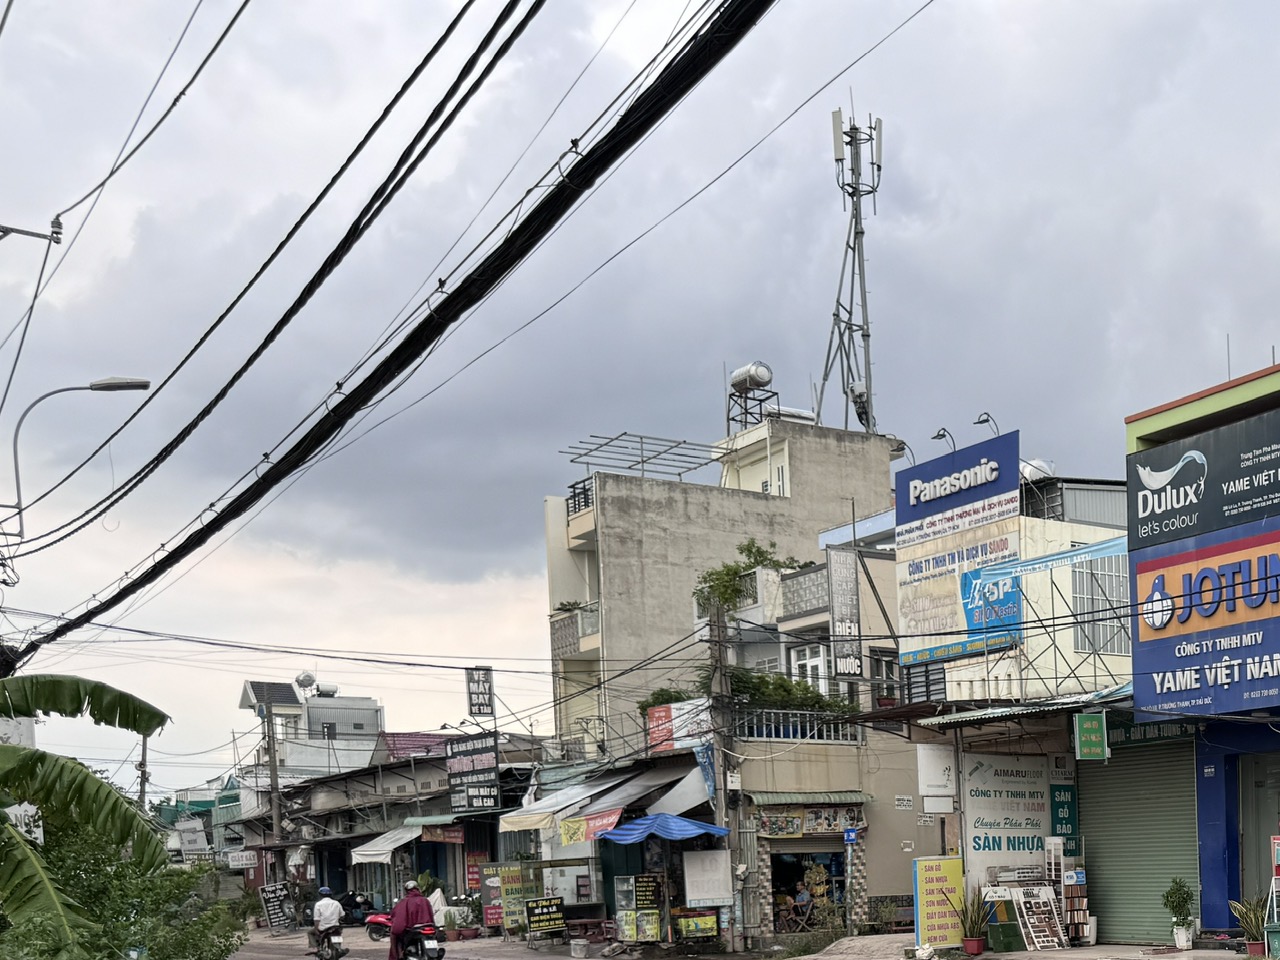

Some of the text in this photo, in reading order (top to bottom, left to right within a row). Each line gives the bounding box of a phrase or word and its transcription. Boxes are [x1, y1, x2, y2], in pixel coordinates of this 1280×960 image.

[909, 458, 999, 506] Panasonic
[1222, 477, 1250, 495] YAME
[1253, 470, 1275, 487] VIỆT
[1138, 483, 1198, 518] Dulux
[1138, 512, 1198, 538] let's colour
[908, 560, 923, 577] CÔNG
[924, 558, 931, 572] TY
[989, 538, 1008, 554] SANDO
[835, 620, 859, 636] ĐIỆN
[1175, 631, 1263, 657] CÔNG TY TNHH MTV
[837, 657, 861, 674] NƯỚC
[1152, 666, 1200, 694] YAME
[1204, 655, 1242, 690] VIỆT
[470, 681, 490, 694] MÁY
[472, 694, 490, 704] BAY
[970, 787, 991, 798] CÔNG
[1006, 790, 1026, 798] TNHH
[1055, 790, 1071, 801] SÀN
[1023, 802, 1045, 812] NAM
[1058, 805, 1069, 818] GỖ
[974, 817, 1041, 829] Chuyên Phân Phối
[1056, 821, 1072, 834] BẢO
[973, 833, 1045, 854] SÀN NHỰA
